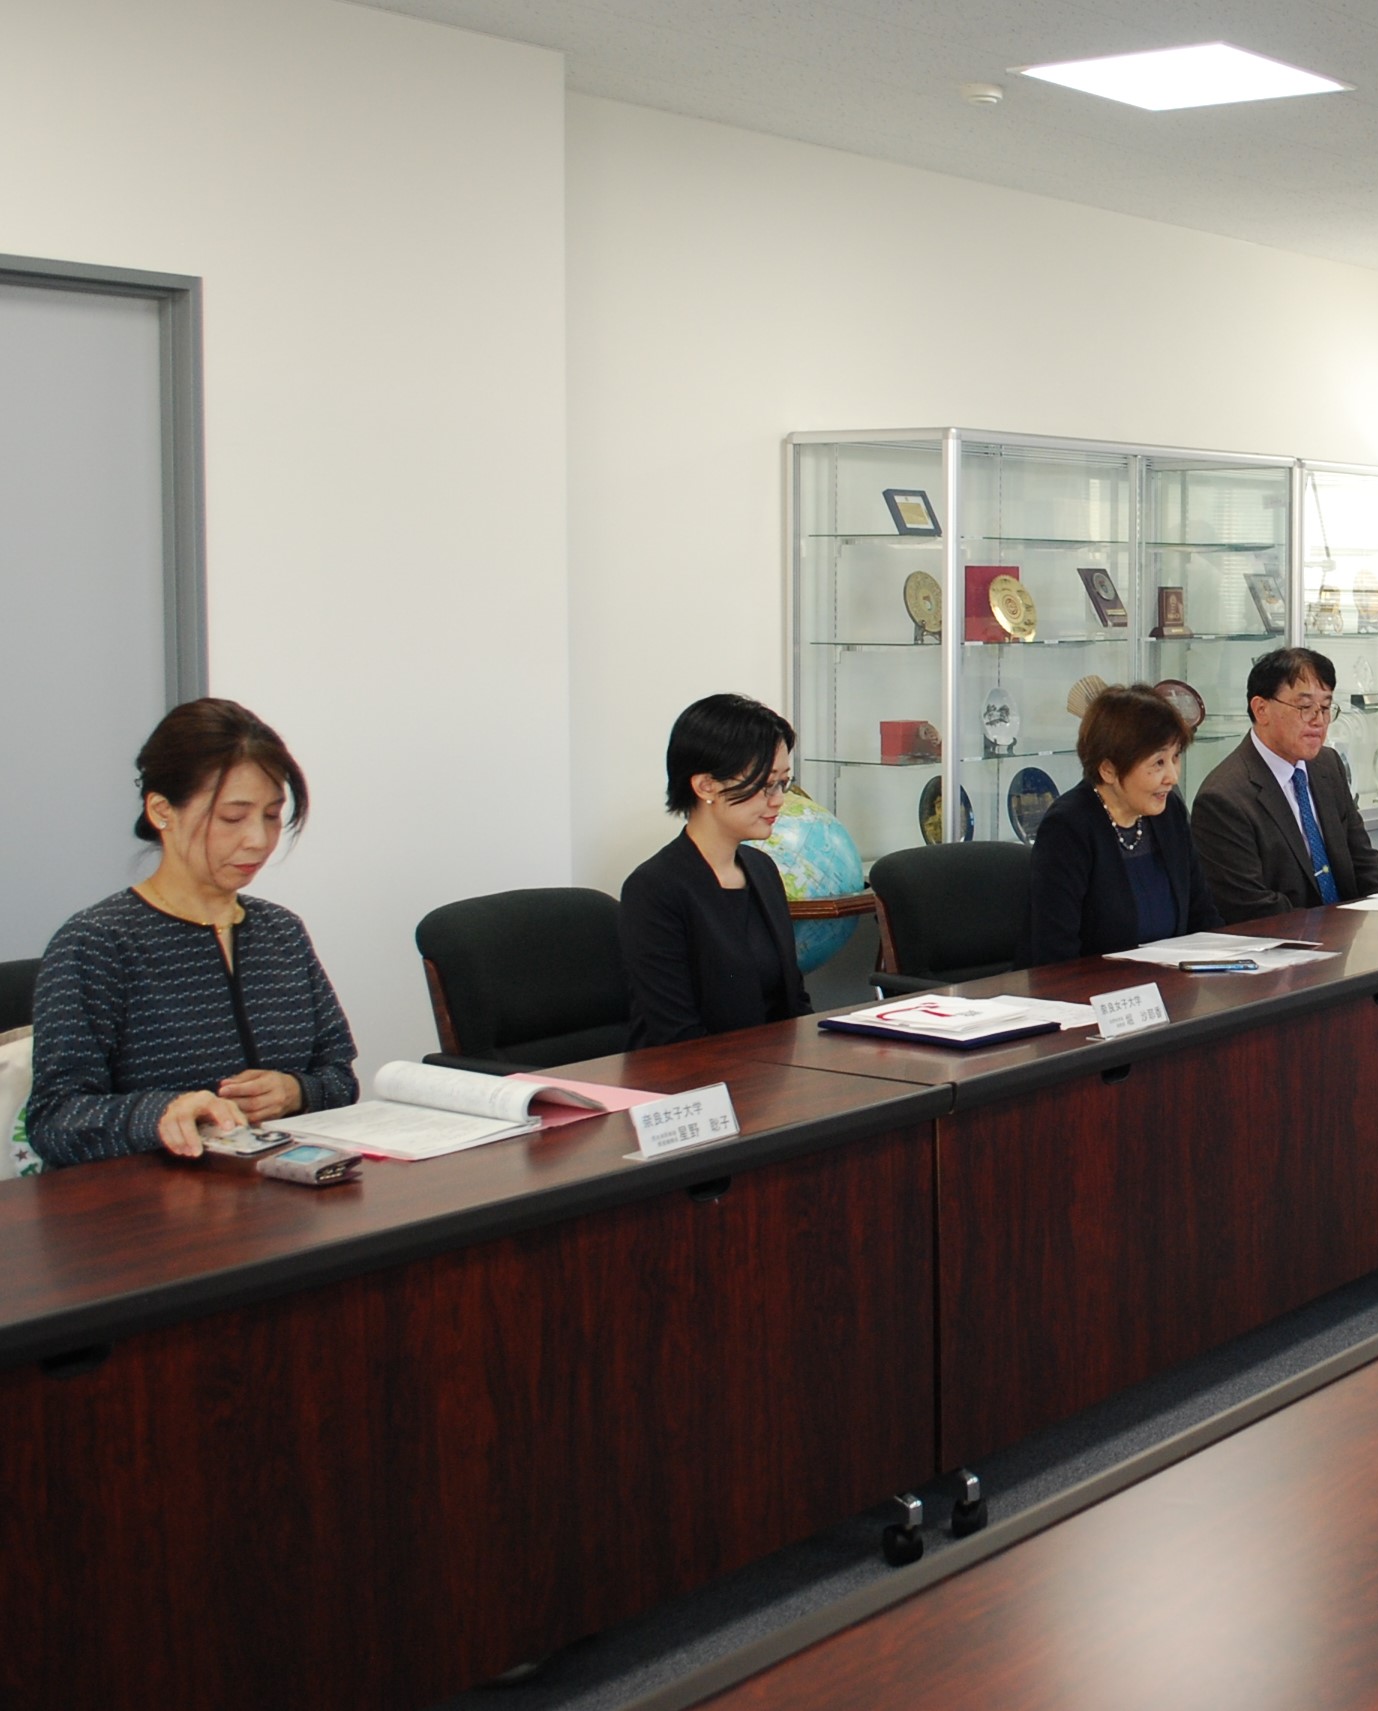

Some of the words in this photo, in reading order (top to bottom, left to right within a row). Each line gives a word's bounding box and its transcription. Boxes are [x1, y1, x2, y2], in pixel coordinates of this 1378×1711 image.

[642, 1101, 703, 1129] 奈良女子大学
